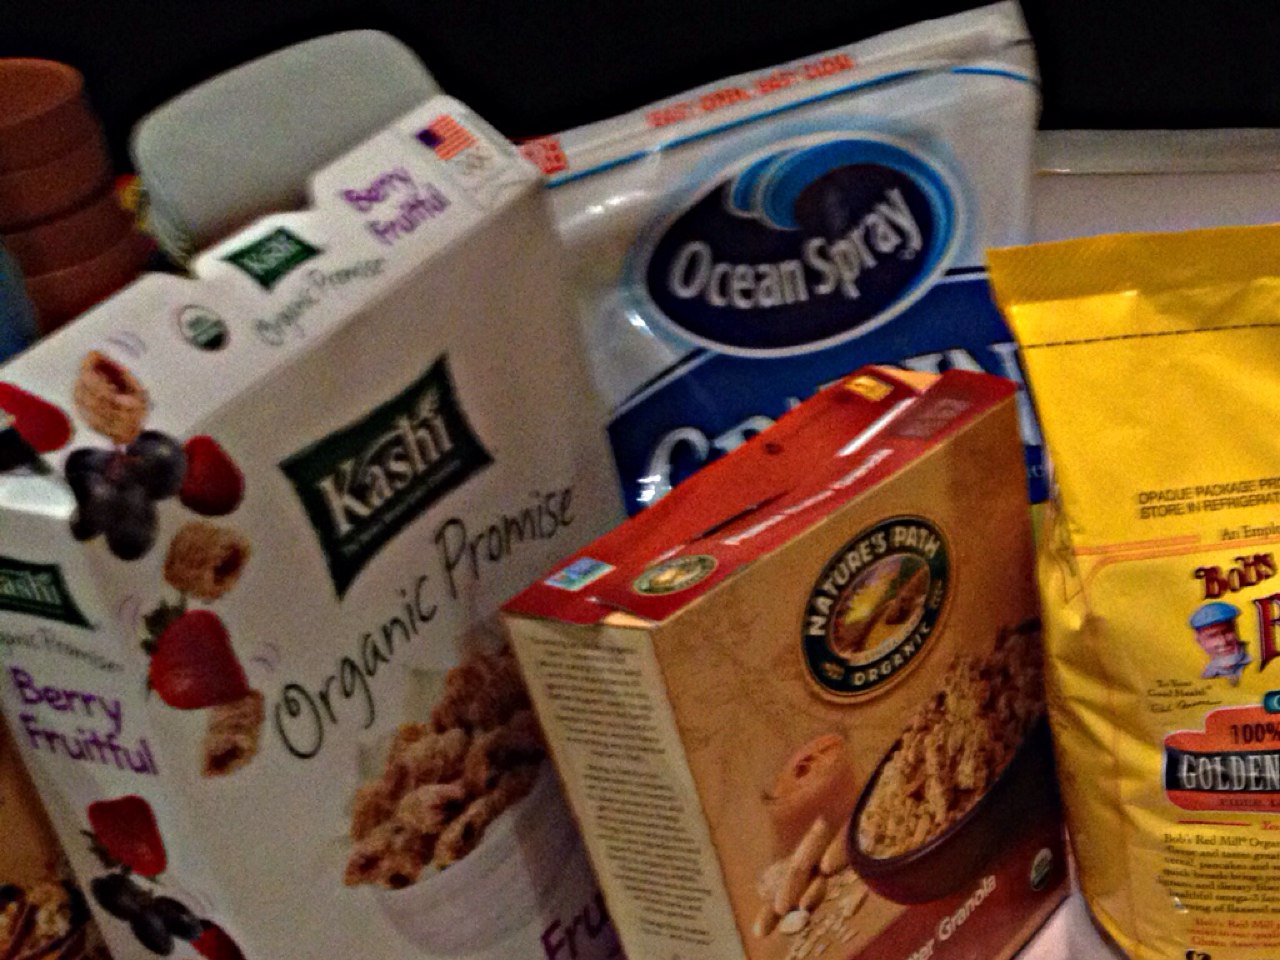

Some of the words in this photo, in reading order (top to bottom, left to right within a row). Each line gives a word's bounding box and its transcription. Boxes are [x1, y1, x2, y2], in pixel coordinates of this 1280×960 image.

[669, 240, 809, 310] Ocean
[803, 187, 923, 300] Spray
[317, 388, 456, 536] Kashi
[1138, 486, 1194, 505] OPAQUE
[1195, 479, 1257, 498] PACKAGE
[1139, 503, 1186, 519] STORE
[807, 531, 888, 637] NATURE'S
[893, 524, 941, 560] PATH
[275, 574, 438, 760] Organic
[434, 483, 577, 602] Promise
[853, 620, 931, 687] ORGANIC
[9, 665, 122, 735] Berry
[18, 712, 160, 776] Fruitful
[1179, 753, 1280, 791] GOLDEN
[1195, 834, 1217, 845] Red
[937, 874, 998, 942] Granola
